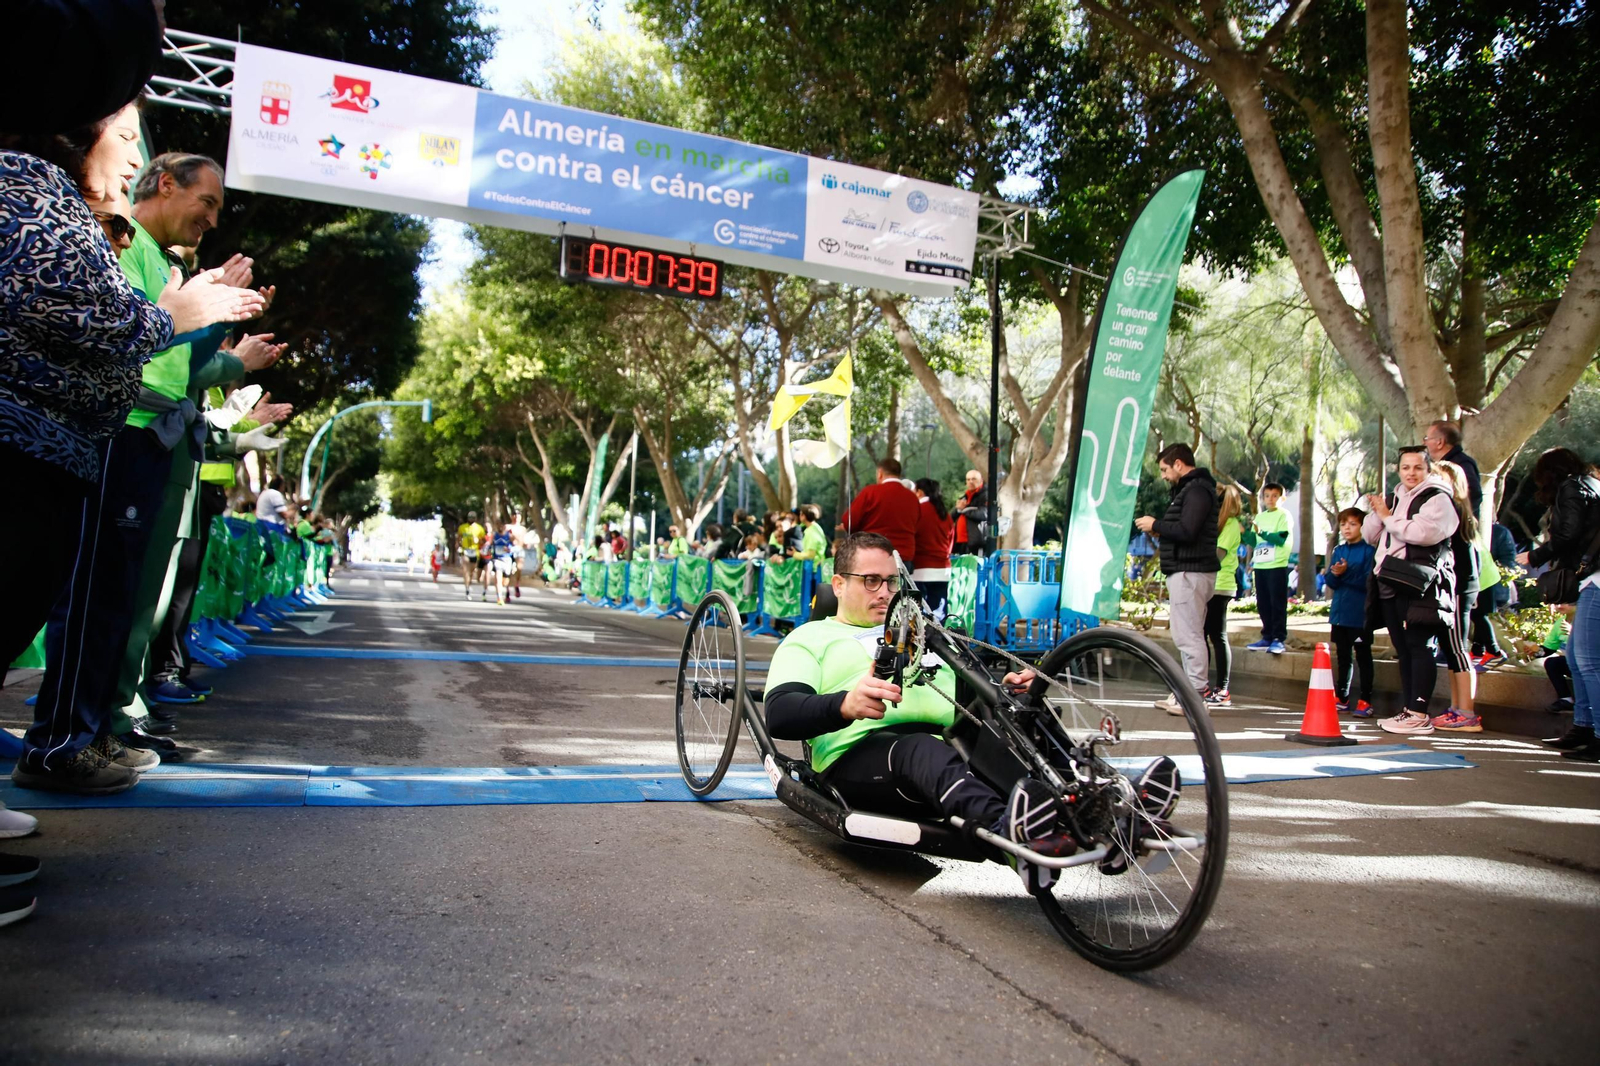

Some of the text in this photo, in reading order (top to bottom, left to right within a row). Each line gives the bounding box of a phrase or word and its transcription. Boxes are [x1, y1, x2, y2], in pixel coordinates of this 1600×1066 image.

[498, 108, 790, 184] Almería en marcha
[495, 149, 755, 210] contra el cáncer
[841, 179, 893, 199] cajamar
[483, 190, 592, 215] #TodosContraElCáncer
[844, 240, 869, 252] Toyota
[874, 256, 895, 267] Motor
[917, 248, 964, 263] Ejido Motor
[1116, 303, 1158, 321] Tenemos
[1112, 321, 1148, 336] un gran
[1108, 335, 1144, 351] camino
[1106, 352, 1122, 363] por
[1102, 364, 1142, 382] delante
